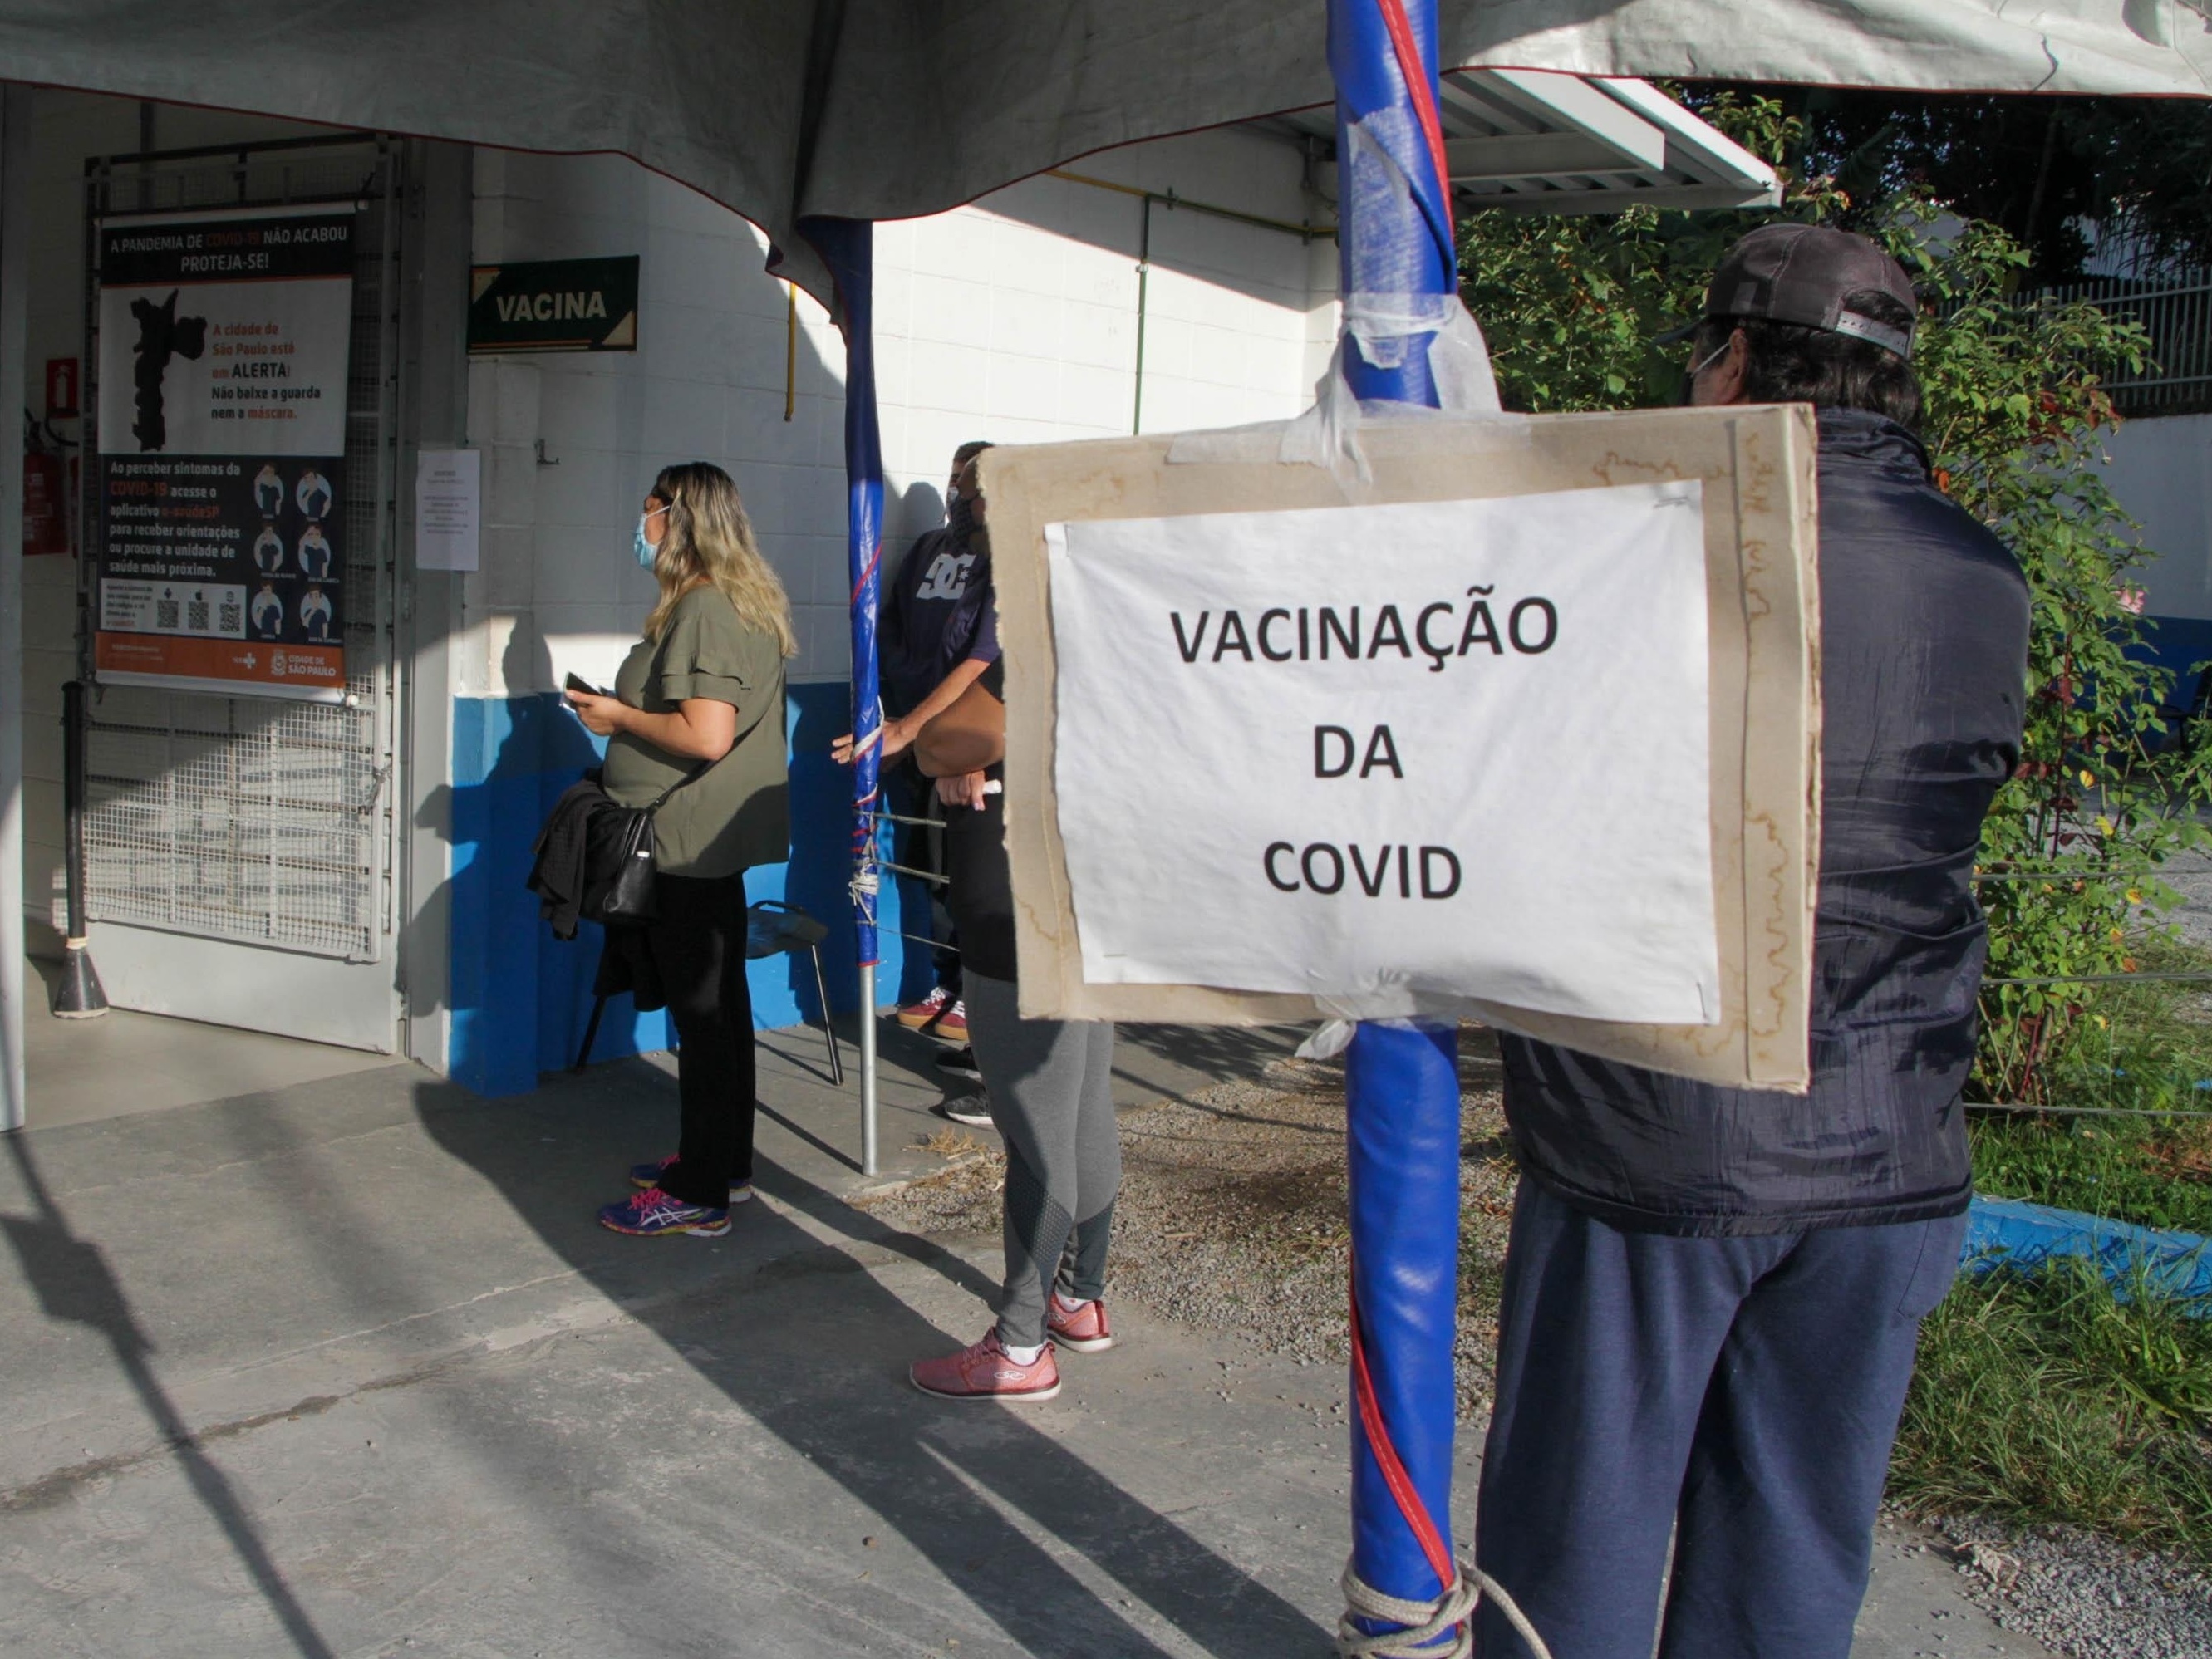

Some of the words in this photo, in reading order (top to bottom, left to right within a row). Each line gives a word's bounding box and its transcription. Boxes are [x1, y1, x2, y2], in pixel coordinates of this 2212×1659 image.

[111, 240, 120, 253] A
[121, 236, 184, 252] PANDEMIA
[187, 233, 203, 248] DE
[263, 227, 291, 245] NÃO
[293, 226, 347, 242] ACABOU
[180, 253, 270, 271] PROTEJA-SE!
[496, 290, 607, 322] VACINA
[213, 324, 221, 336] A
[224, 322, 263, 336] cidade
[265, 321, 279, 335] de
[213, 342, 233, 356] São
[236, 342, 268, 356] Paulo
[271, 341, 295, 355] está
[213, 370, 229, 378] em
[212, 386, 233, 399] Não
[237, 385, 268, 399] baixe
[281, 385, 321, 402] guarda
[211, 409, 235, 419] nem
[238, 409, 244, 419] a
[111, 461, 125, 474] Ao
[126, 461, 171, 477] perceber
[175, 462, 224, 475] sintomas
[226, 461, 241, 475] da
[110, 480, 168, 497] COVID-19
[170, 487, 208, 498] acesse
[209, 488, 217, 498] o
[110, 503, 160, 518] aplicativo
[110, 525, 132, 537] para
[134, 523, 174, 537] receber
[176, 524, 241, 541] orientações
[109, 543, 122, 553] ou
[125, 544, 163, 557] procure
[165, 545, 172, 556] a
[175, 543, 219, 557] unidade
[221, 544, 235, 558] de
[109, 559, 140, 573] saúde
[141, 561, 166, 574] mais
[169, 562, 217, 577] próxima.
[1170, 585, 1557, 672] VACINAÇÃO
[288, 655, 314, 665] CIDADE
[315, 656, 325, 665] DE
[288, 664, 307, 675] SÃO
[307, 665, 337, 676] PAULO
[1315, 724, 1403, 778] DA
[1263, 841, 1461, 898] COVID
